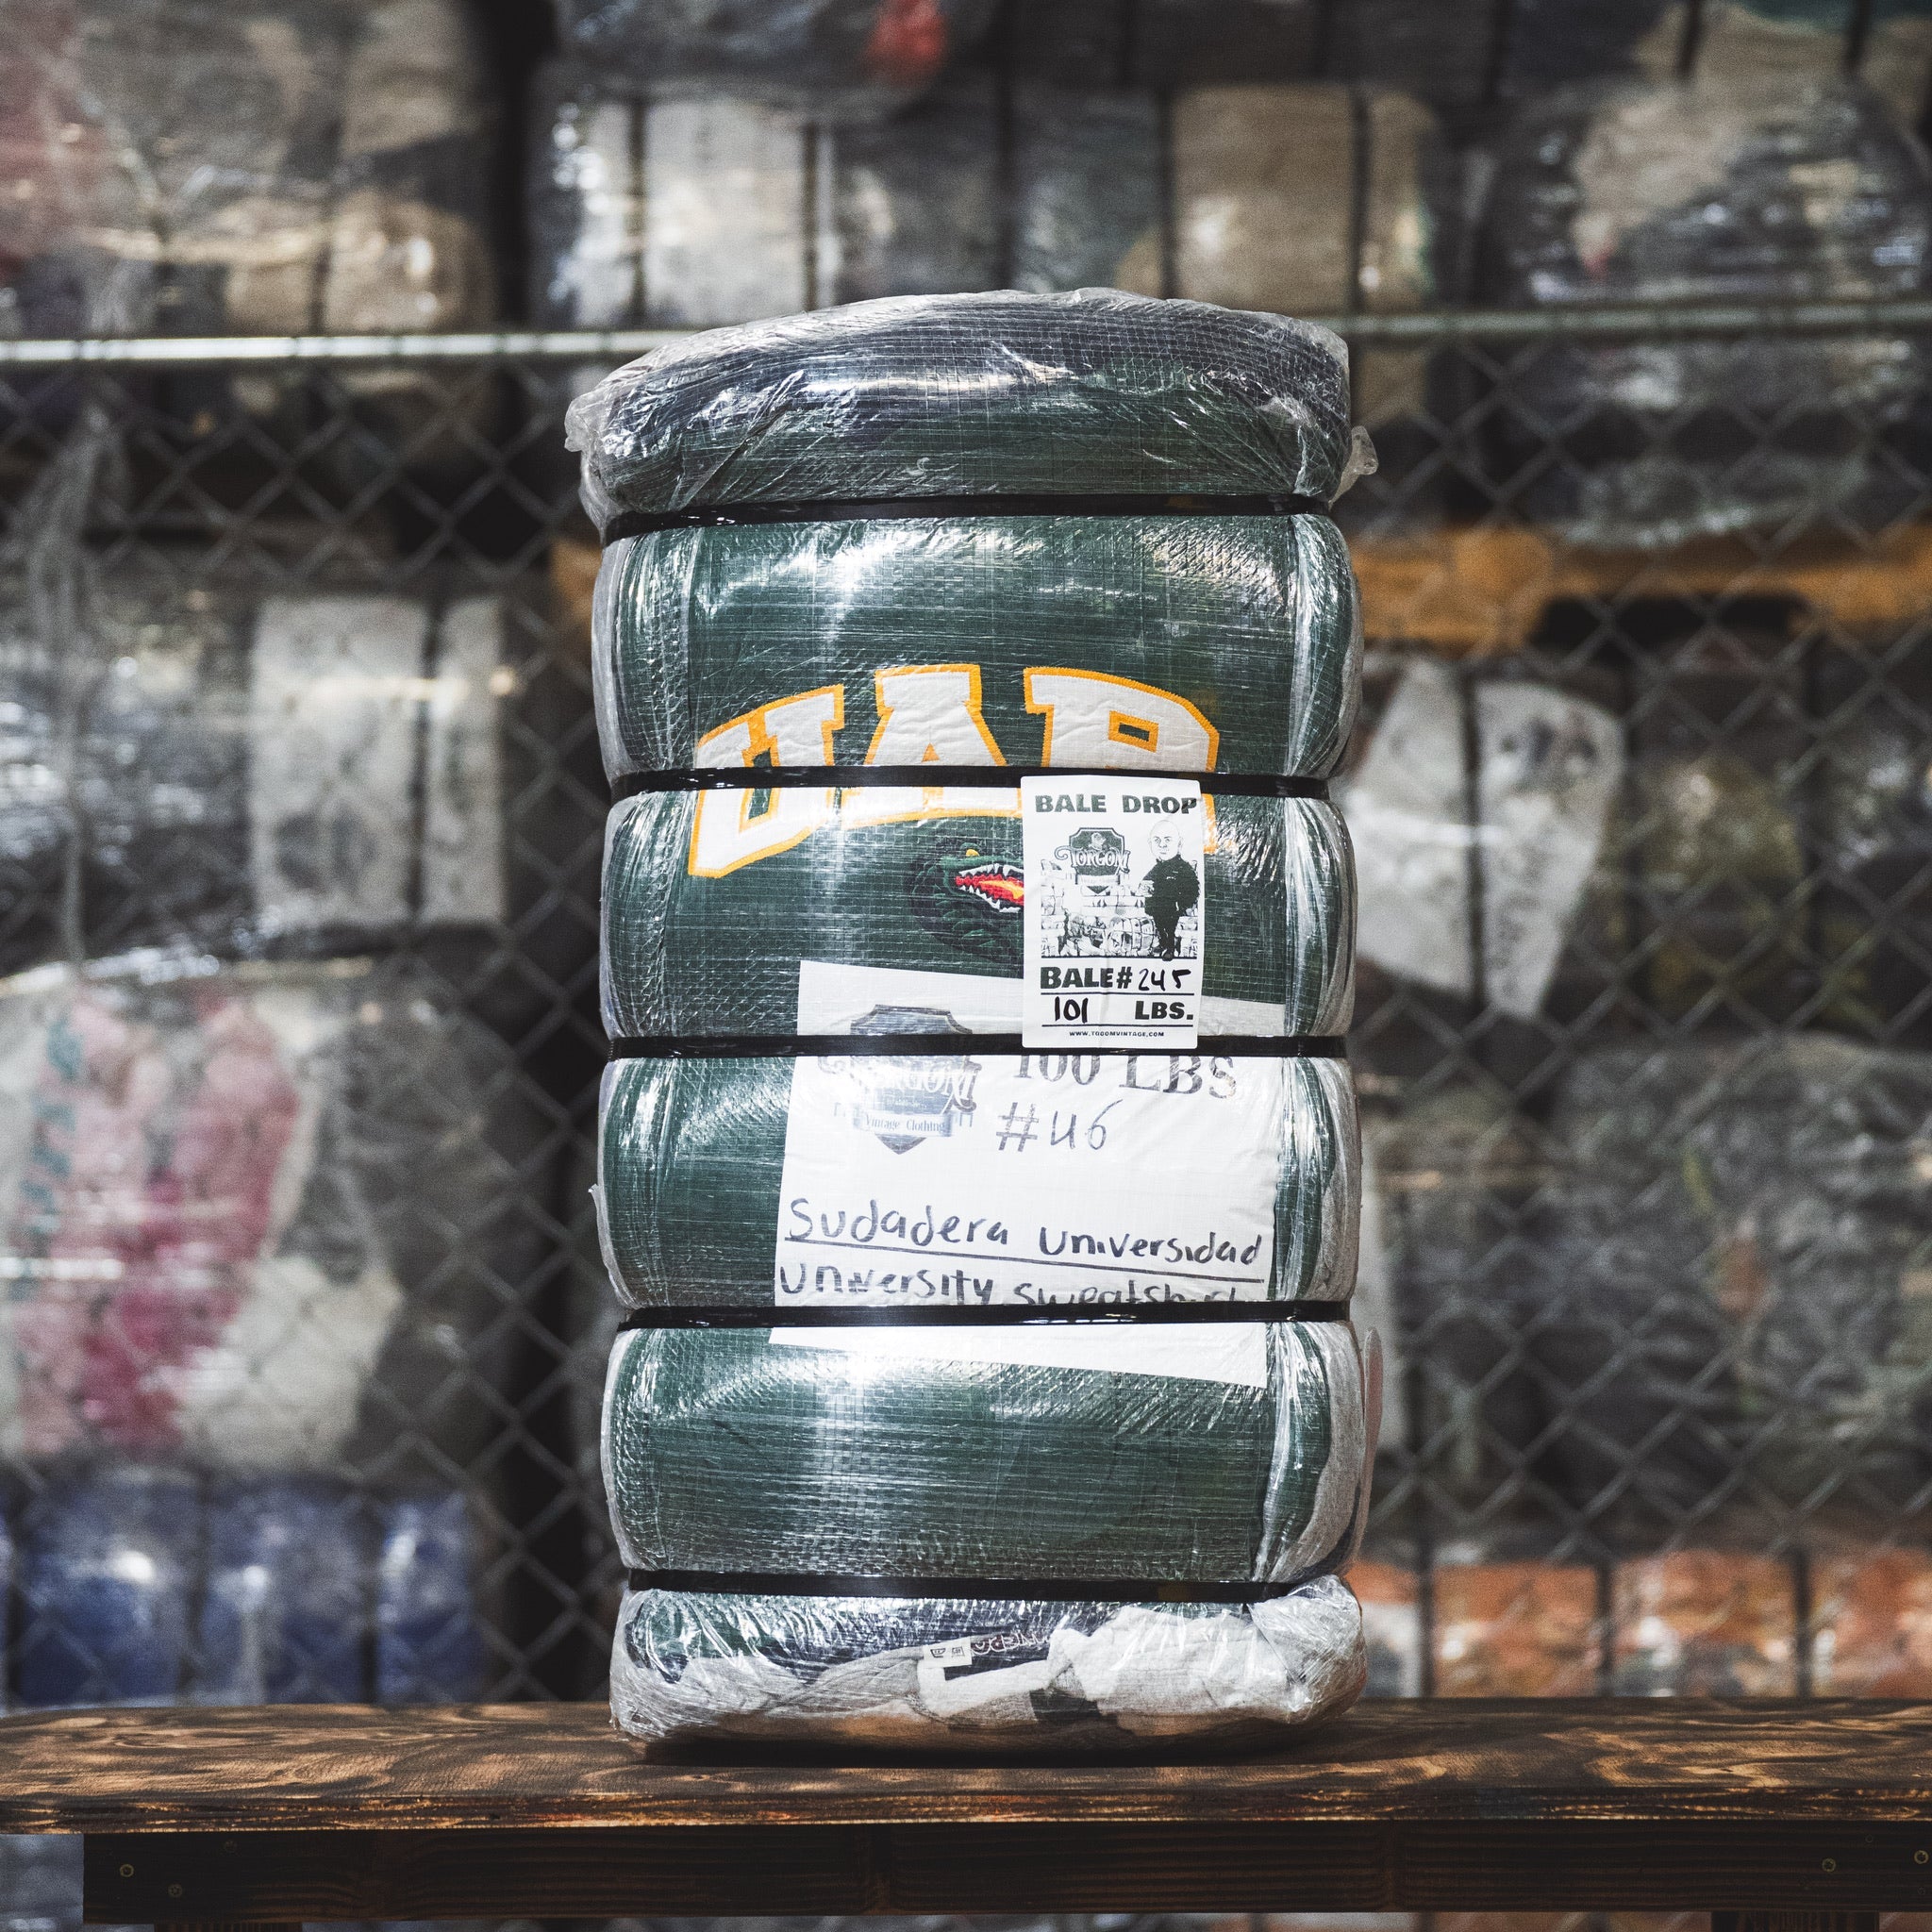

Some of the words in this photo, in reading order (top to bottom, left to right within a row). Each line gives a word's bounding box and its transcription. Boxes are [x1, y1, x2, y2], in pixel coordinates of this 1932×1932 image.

[1035, 794, 1106, 813] BALE
[1122, 795, 1197, 814] DROP
[1058, 845, 1131, 874] TORGOM
[1138, 968, 1191, 991] 245
[1054, 996, 1088, 1024] 101
[1135, 1000, 1194, 1021] LBS.
[1119, 1055, 1237, 1099] LBS
[864, 1113, 900, 1131] Vintage
[789, 1198, 1008, 1246] Sudadera
